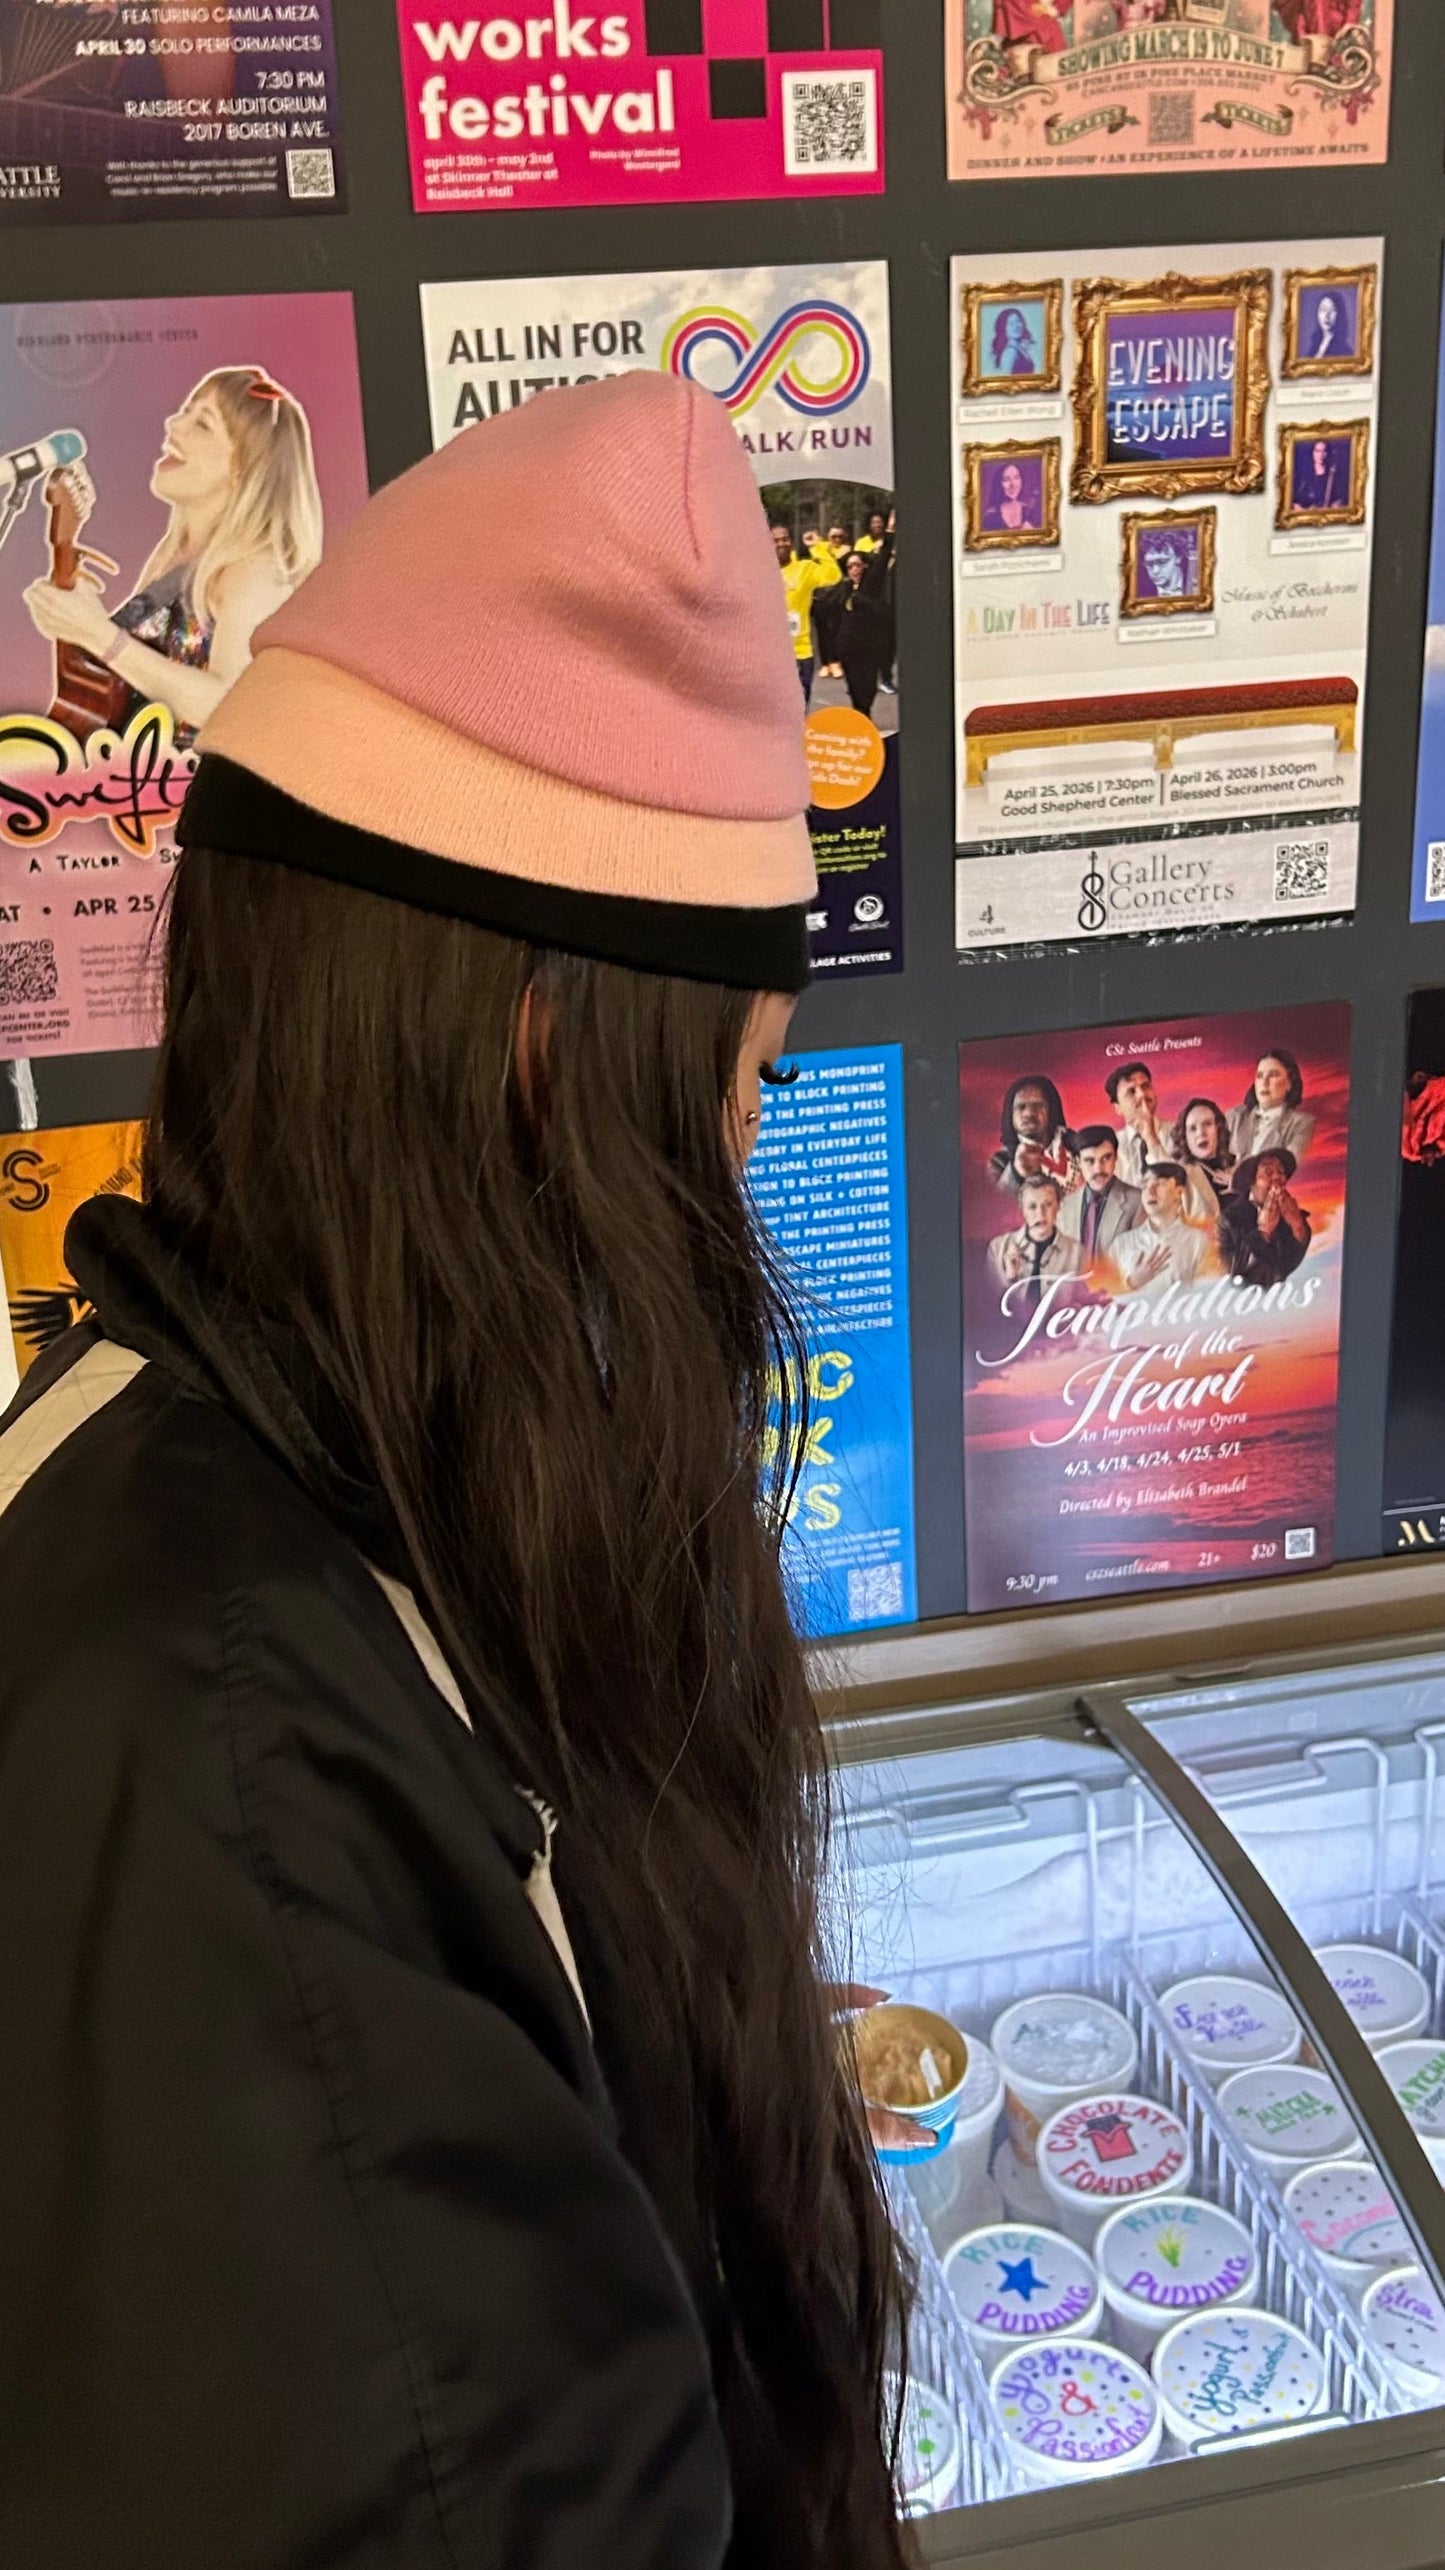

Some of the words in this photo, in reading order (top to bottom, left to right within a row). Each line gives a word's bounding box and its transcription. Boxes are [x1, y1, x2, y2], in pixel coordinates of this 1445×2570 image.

[122, 7, 209, 24] FEATURING
[211, 6, 273, 22] CAMILA
[275, 5, 319, 21] MEZA
[413, 0, 631, 61] works
[76, 40, 122, 56] APRIL
[124, 38, 146, 55] 30
[149, 37, 193, 54] SOLO
[195, 35, 321, 53] PERFORMANCES
[1058, 33, 1131, 76] SHOWING
[1134, 28, 1190, 59] MARCH
[1212, 29, 1232, 60] TO
[1233, 33, 1273, 66] JUNE
[256, 71, 293, 89] 7:30
[297, 71, 325, 88] PM
[124, 98, 212, 118] RAISBECK
[217, 95, 327, 115] AUDITORIUM
[419, 68, 674, 140] festival
[183, 123, 223, 142] 2017
[226, 121, 287, 140] BOREN
[290, 120, 330, 138] AVE.
[1024, 156, 1053, 167] AND
[1056, 154, 1097, 165] SHOW
[1130, 150, 1215, 162] EXPERIENCE
[1252, 145, 1314, 158] LIFETIME
[1318, 143, 1368, 154] AWAITS
[448, 329, 516, 364] ALL
[524, 324, 562, 360] IN
[572, 320, 646, 358] FOR
[1108, 335, 1235, 386] EVENING
[1113, 393, 1228, 444] ESCAPE
[1170, 771, 1201, 787] April
[1205, 769, 1223, 782] 26,
[1227, 767, 1258, 780] 2026
[1268, 762, 1317, 777] 3:00pm
[1004, 786, 1037, 801] April
[1041, 785, 1057, 797] 25,
[1062, 782, 1095, 796] 2026
[1105, 777, 1154, 792] 7:30pm
[1170, 786, 1221, 801] Blessed
[1224, 780, 1294, 797] Sacrament
[1298, 775, 1344, 790] Church
[1001, 803, 1037, 817] Good
[1041, 799, 1106, 815] Shepherd
[1109, 794, 1155, 808] Center
[811, 832, 840, 844] ister
[841, 824, 886, 842] Today!
[30, 857, 42, 874] A
[57, 855, 121, 872] TAYLOR
[1110, 854, 1212, 886] Gallery
[1109, 882, 1235, 911] Concerts
[0, 905, 21, 923] AT
[74, 897, 118, 917] APR
[128, 895, 155, 913] 25
[837, 951, 892, 965] ACTIVITIES
[1127, 1037, 1160, 1055] Seattle
[1163, 1036, 1202, 1051] Presents
[819, 1063, 886, 1079] MONOPRINT
[778, 1091, 791, 1102] TO
[794, 1087, 829, 1100] BLOCK
[832, 1080, 886, 1096] PRINTING
[775, 1108, 794, 1120] THE
[798, 1102, 850, 1117] PRINTING
[853, 1098, 886, 1111] PRESS
[829, 1115, 887, 1131] NEGATIVES
[791, 1143, 804, 1154] IN
[807, 1136, 861, 1152] EVERYDAY
[865, 1132, 887, 1145] LIFE
[768, 1160, 808, 1174] FLORAL
[812, 1150, 888, 1168] CENTERPIECES
[782, 1179, 796, 1189] TO
[799, 1174, 833, 1187] BLOCK
[836, 1167, 888, 1182] PRINTING
[789, 1195, 805, 1206] ON
[809, 1191, 833, 1203] SILK
[849, 1185, 889, 1199] COTTON
[784, 1211, 809, 1223] TINY
[812, 1201, 890, 1219] ARCHITECTURE
[781, 1229, 800, 1240] THE
[804, 1222, 855, 1238] PRINTING
[858, 1218, 891, 1231] PRESS
[826, 1234, 891, 1251] MINIATURES
[816, 1251, 891, 1269] CENTERPIECES
[840, 1267, 892, 1282] PRINTING
[975, 1271, 1321, 1367] Temptations
[1163, 1330, 1192, 1368] of
[1200, 1328, 1243, 1357] the
[1030, 1345, 1255, 1448] Heart
[1079, 1430, 1097, 1444] An
[1102, 1415, 1172, 1444] Improvised
[1176, 1417, 1206, 1436] Soap
[1210, 1411, 1248, 1433] Opera
[1064, 1459, 1092, 1477] 4/3,
[1097, 1455, 1132, 1475] 4/18,
[1137, 1450, 1173, 1468] 4/24,
[1178, 1444, 1214, 1464] 4/25,
[1217, 1441, 1241, 1459] 5/1
[1059, 1490, 1112, 1514] Directed
[1116, 1490, 1132, 1512] by
[1136, 1481, 1195, 1506] Elizabeth
[1005, 1573, 1034, 1591] 9:30
[1034, 1573, 1058, 1594] pm
[1251, 1542, 1278, 1561] $20
[1046, 2101, 1179, 2152] CHOCOLATE
[1120, 2204, 1201, 2234] RICE
[958, 2234, 1044, 2265] RICE
[1124, 2255, 1247, 2307] PUDDING
[976, 2284, 1092, 2334] PUDDING
[1060, 2380, 1098, 2416] &
